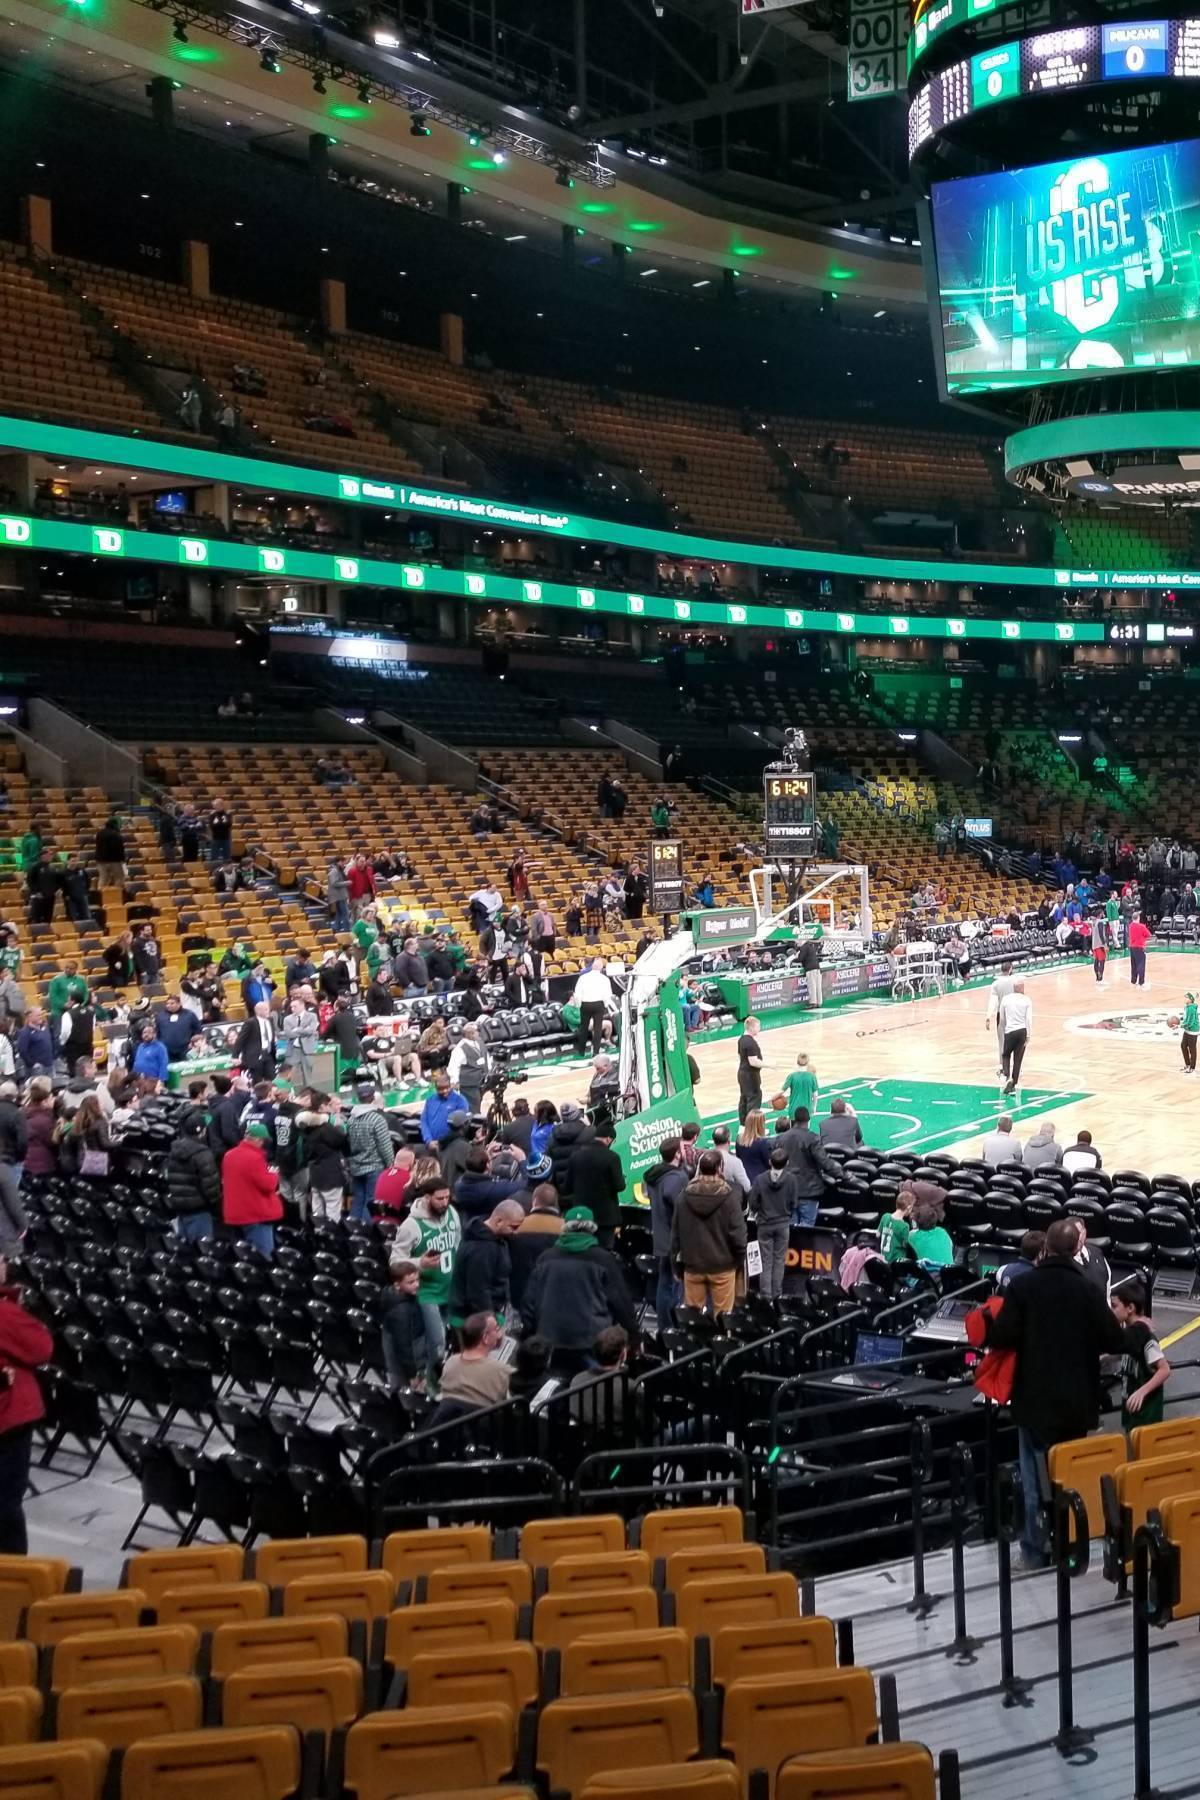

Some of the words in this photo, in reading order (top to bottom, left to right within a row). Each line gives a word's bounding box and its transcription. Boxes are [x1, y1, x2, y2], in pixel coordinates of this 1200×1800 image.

[853, 14, 892, 49] 00
[1126, 45, 1145, 72] 0
[854, 52, 891, 92] 34
[987, 71, 1002, 97] 0
[1027, 214, 1066, 281] US
[1073, 192, 1135, 264] RISE
[139, 243, 161, 258] 302
[340, 479, 359, 497] TD
[409, 492, 459, 510] America's
[460, 500, 485, 515] Most
[486, 505, 540, 524] Convenient
[0, 519, 30, 541] TD
[94, 530, 122, 552] TD
[181, 540, 207, 561] TD
[260, 549, 285, 571] TD
[336, 559, 358, 579] TD
[404, 567, 425, 587] TD
[466, 575, 485, 593] TD
[1112, 574, 1155, 584] America's
[523, 582, 541, 600] TD
[283, 597, 298, 611] TD
[1110, 625, 1139, 639] 6:31
[781, 827, 811, 835] TISSOT
[836, 968, 860, 979] KYOCERA
[873, 963, 889, 972] KYOCE
[756, 981, 782, 993] KYOCERA
[650, 1030, 660, 1082] Putnam
[632, 1116, 674, 1139] Boston
[630, 1154, 658, 1170] Advancing
[1112, 1215, 1134, 1223] Putnam
[1154, 1219, 1176, 1227] Putnam
[426, 1231, 455, 1251] BOSTO
[441, 1250, 452, 1273] 0
[785, 1248, 833, 1271] DEN
